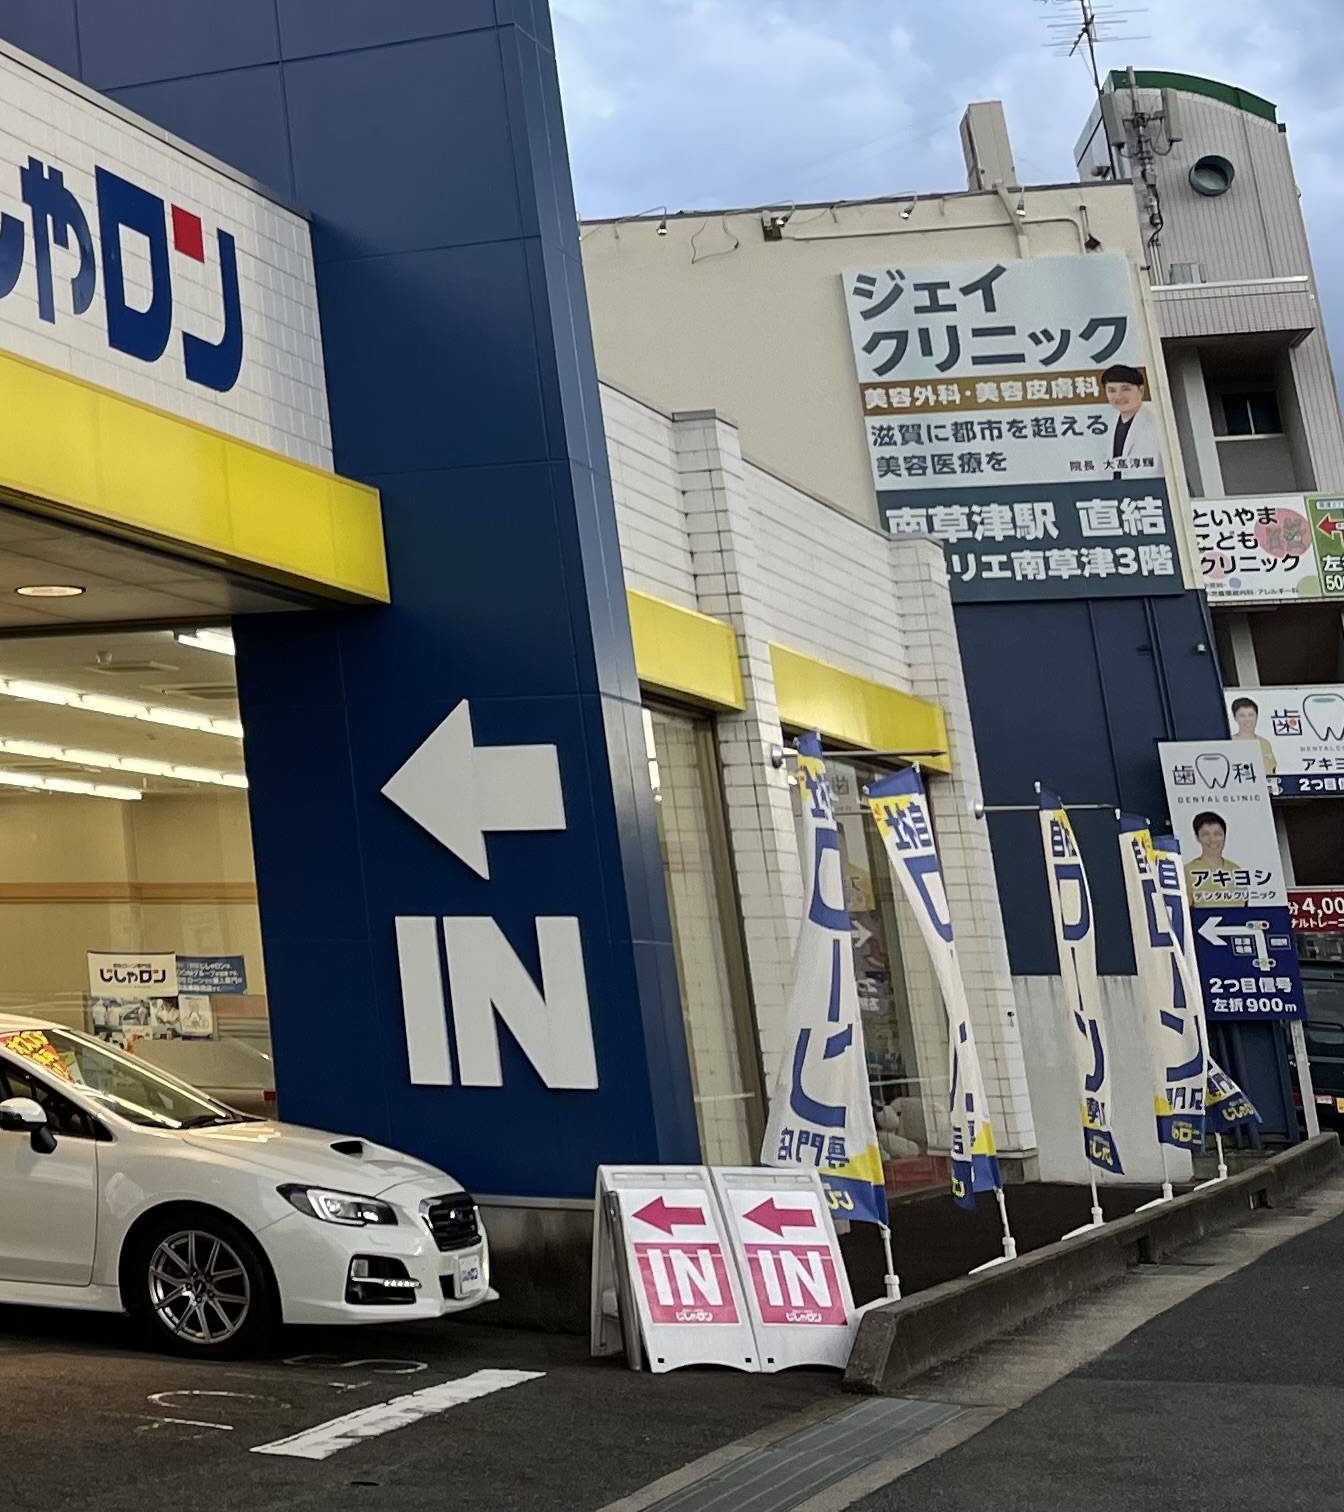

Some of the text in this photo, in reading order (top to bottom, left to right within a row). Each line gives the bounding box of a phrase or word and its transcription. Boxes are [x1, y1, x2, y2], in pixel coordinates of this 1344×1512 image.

[853, 263, 1007, 321] ジェイ
[862, 316, 1128, 377] クリニック
[871, 414, 1109, 447] 滋賀に都市を超える
[876, 451, 1007, 477] 美容医療を
[885, 496, 1166, 543] 南草津駅 直結
[1200, 553, 1300, 575] クリニック
[1325, 574, 1344, 591] 50
[1191, 869, 1273, 888] アキヨシ
[100, 967, 166, 984] じしゃロン
[1209, 976, 1293, 994] 2つ目信号
[395, 915, 599, 1089] IN
[646, 1248, 724, 1306] IN
[757, 1249, 833, 1307] IN
